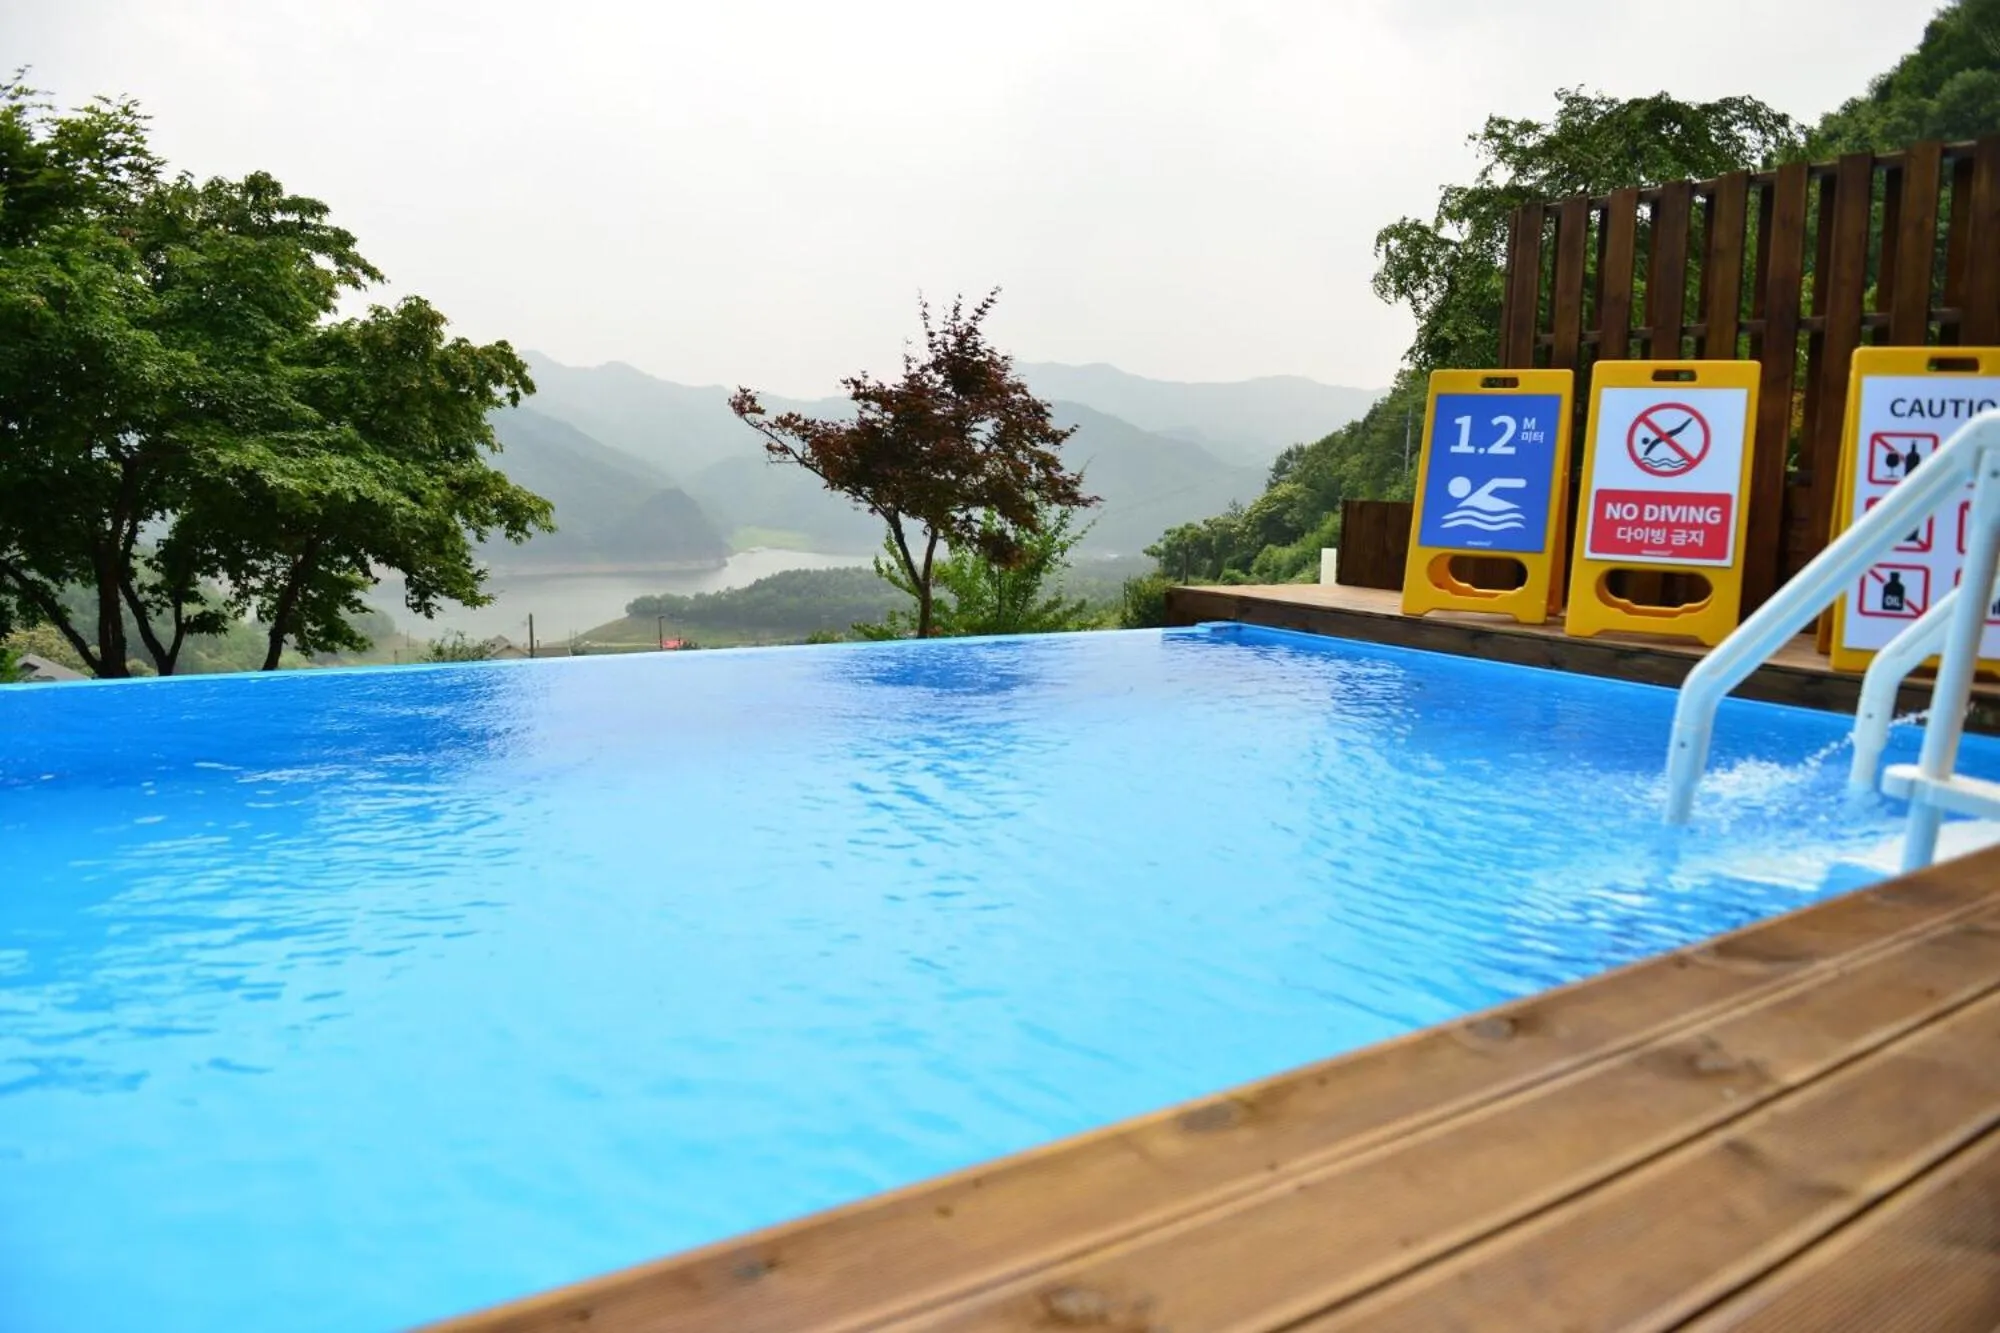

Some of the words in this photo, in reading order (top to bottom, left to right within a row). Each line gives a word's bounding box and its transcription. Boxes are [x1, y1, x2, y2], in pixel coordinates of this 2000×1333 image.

[1450, 415, 1517, 455] 1.2
[1523, 417, 1536, 430] M
[1521, 431, 1544, 443] 미터
[1605, 502, 1639, 520] NO
[1643, 504, 1722, 525] DIVING
[1616, 526, 1667, 545] 다이빙
[1670, 528, 1705, 547] 금지
[1885, 595, 1900, 606] OIL
